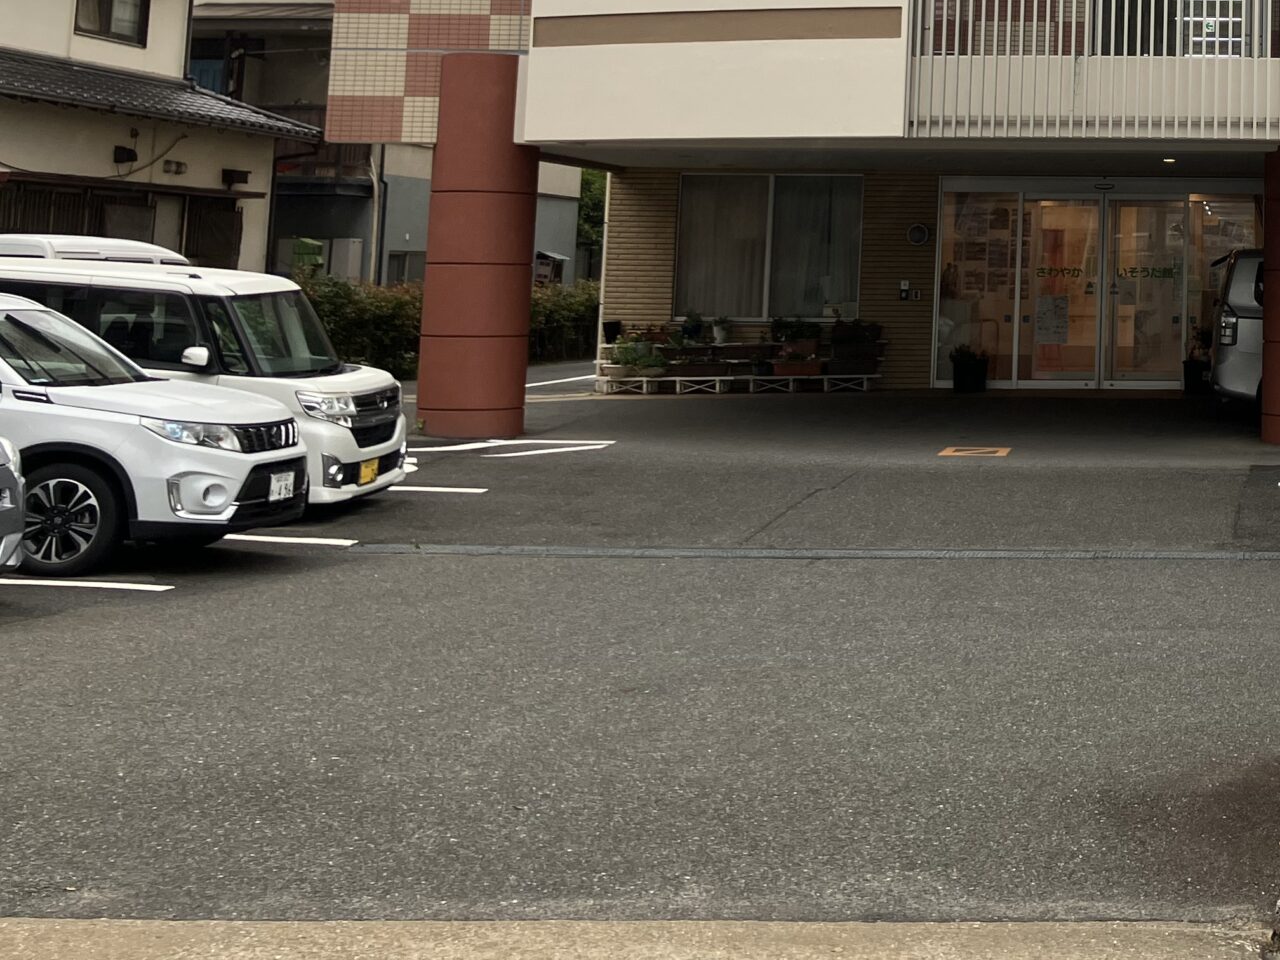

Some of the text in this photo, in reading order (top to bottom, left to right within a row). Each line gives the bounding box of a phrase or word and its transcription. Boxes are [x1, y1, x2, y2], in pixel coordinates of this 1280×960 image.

[1036, 266, 1175, 279] さわやか いそうだ館
